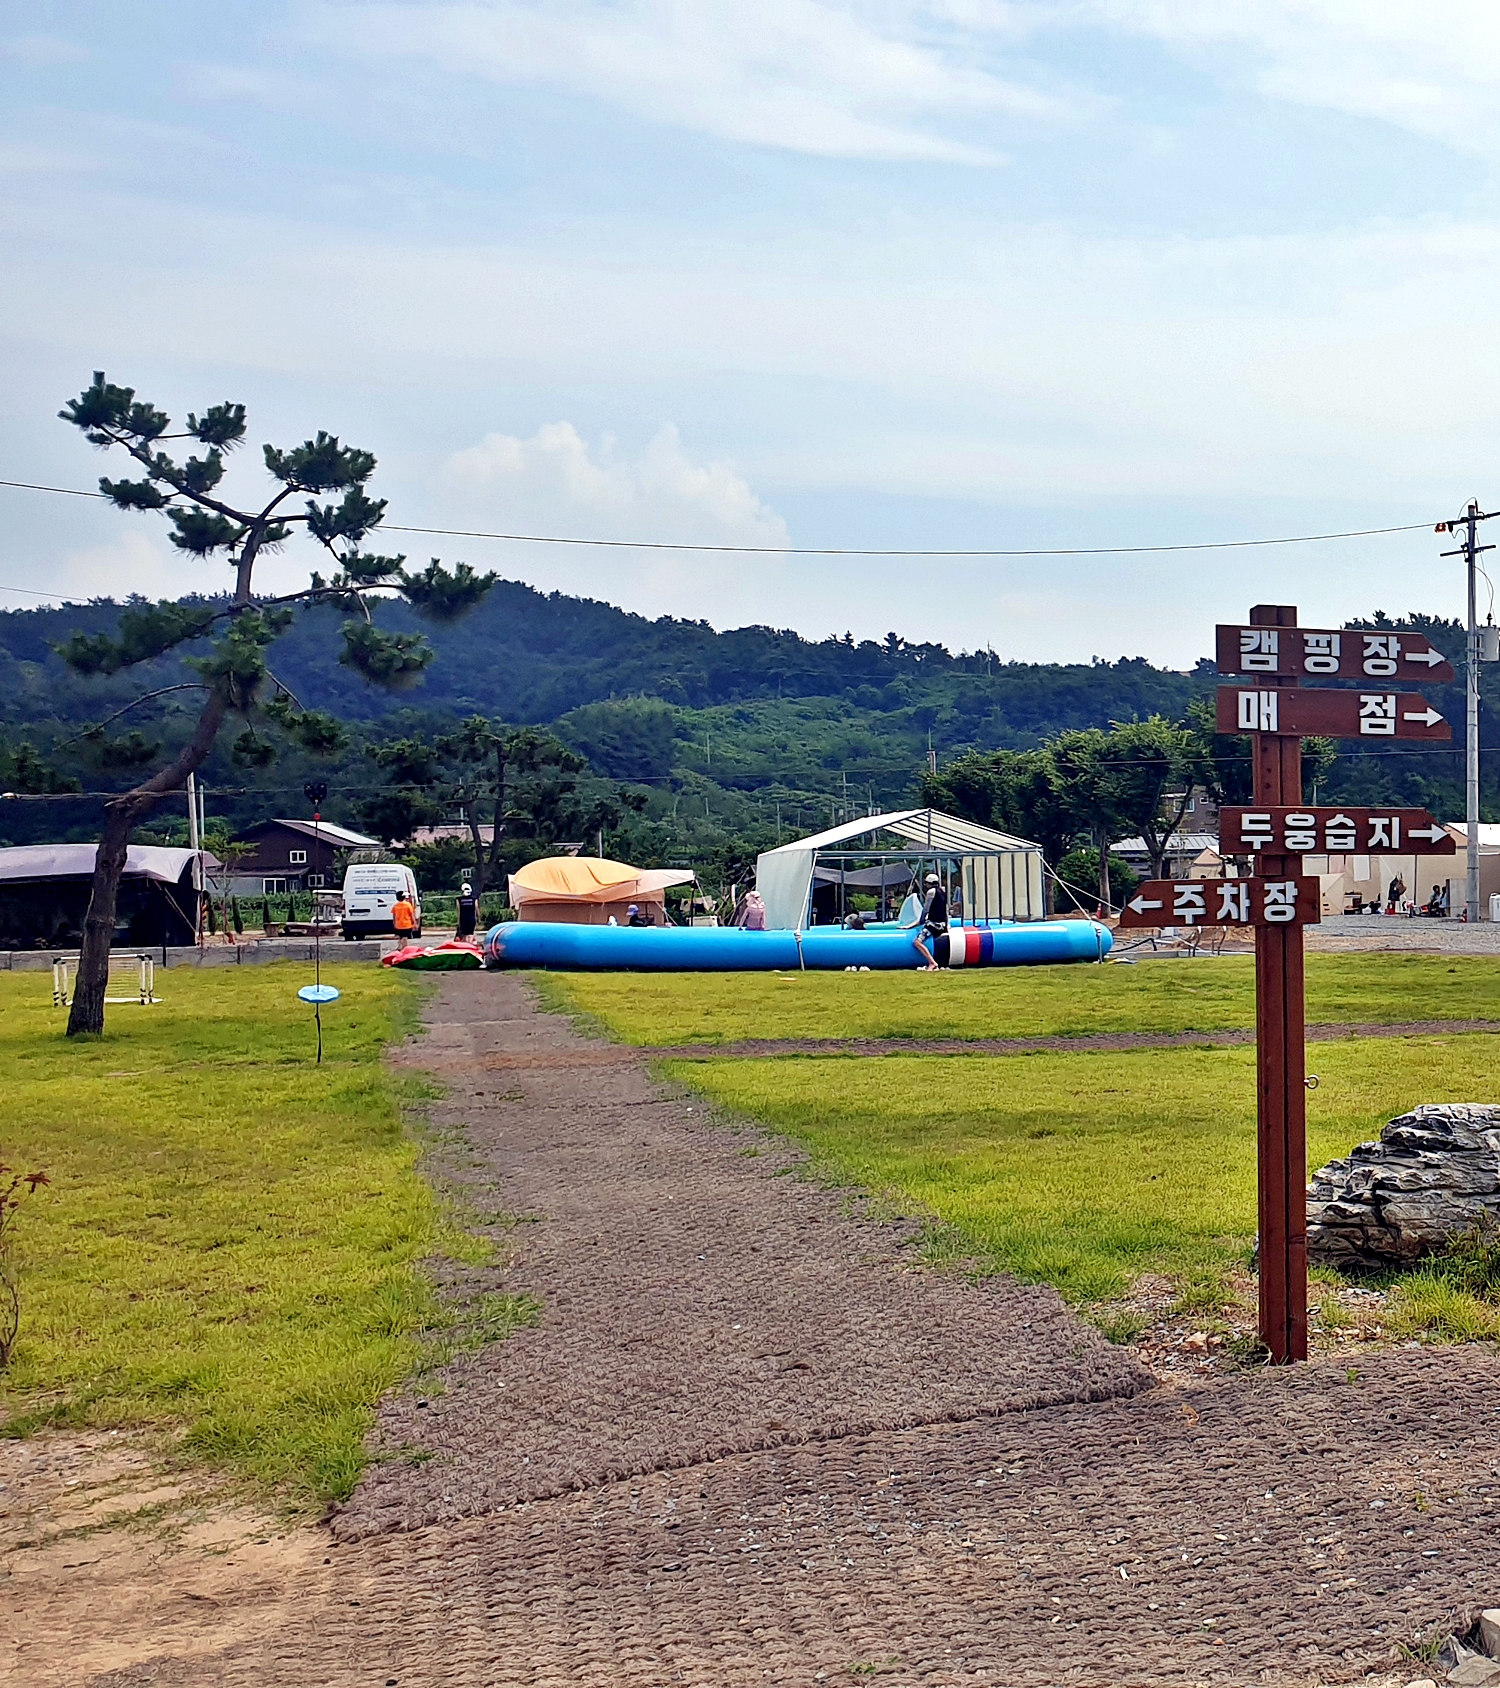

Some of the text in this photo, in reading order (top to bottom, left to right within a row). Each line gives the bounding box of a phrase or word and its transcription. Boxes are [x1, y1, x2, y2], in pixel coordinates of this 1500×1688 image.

[1239, 630, 1401, 676] 캠핑장
[1240, 813, 1400, 850] 두웅습지
[1173, 881, 1298, 924] 주차장
